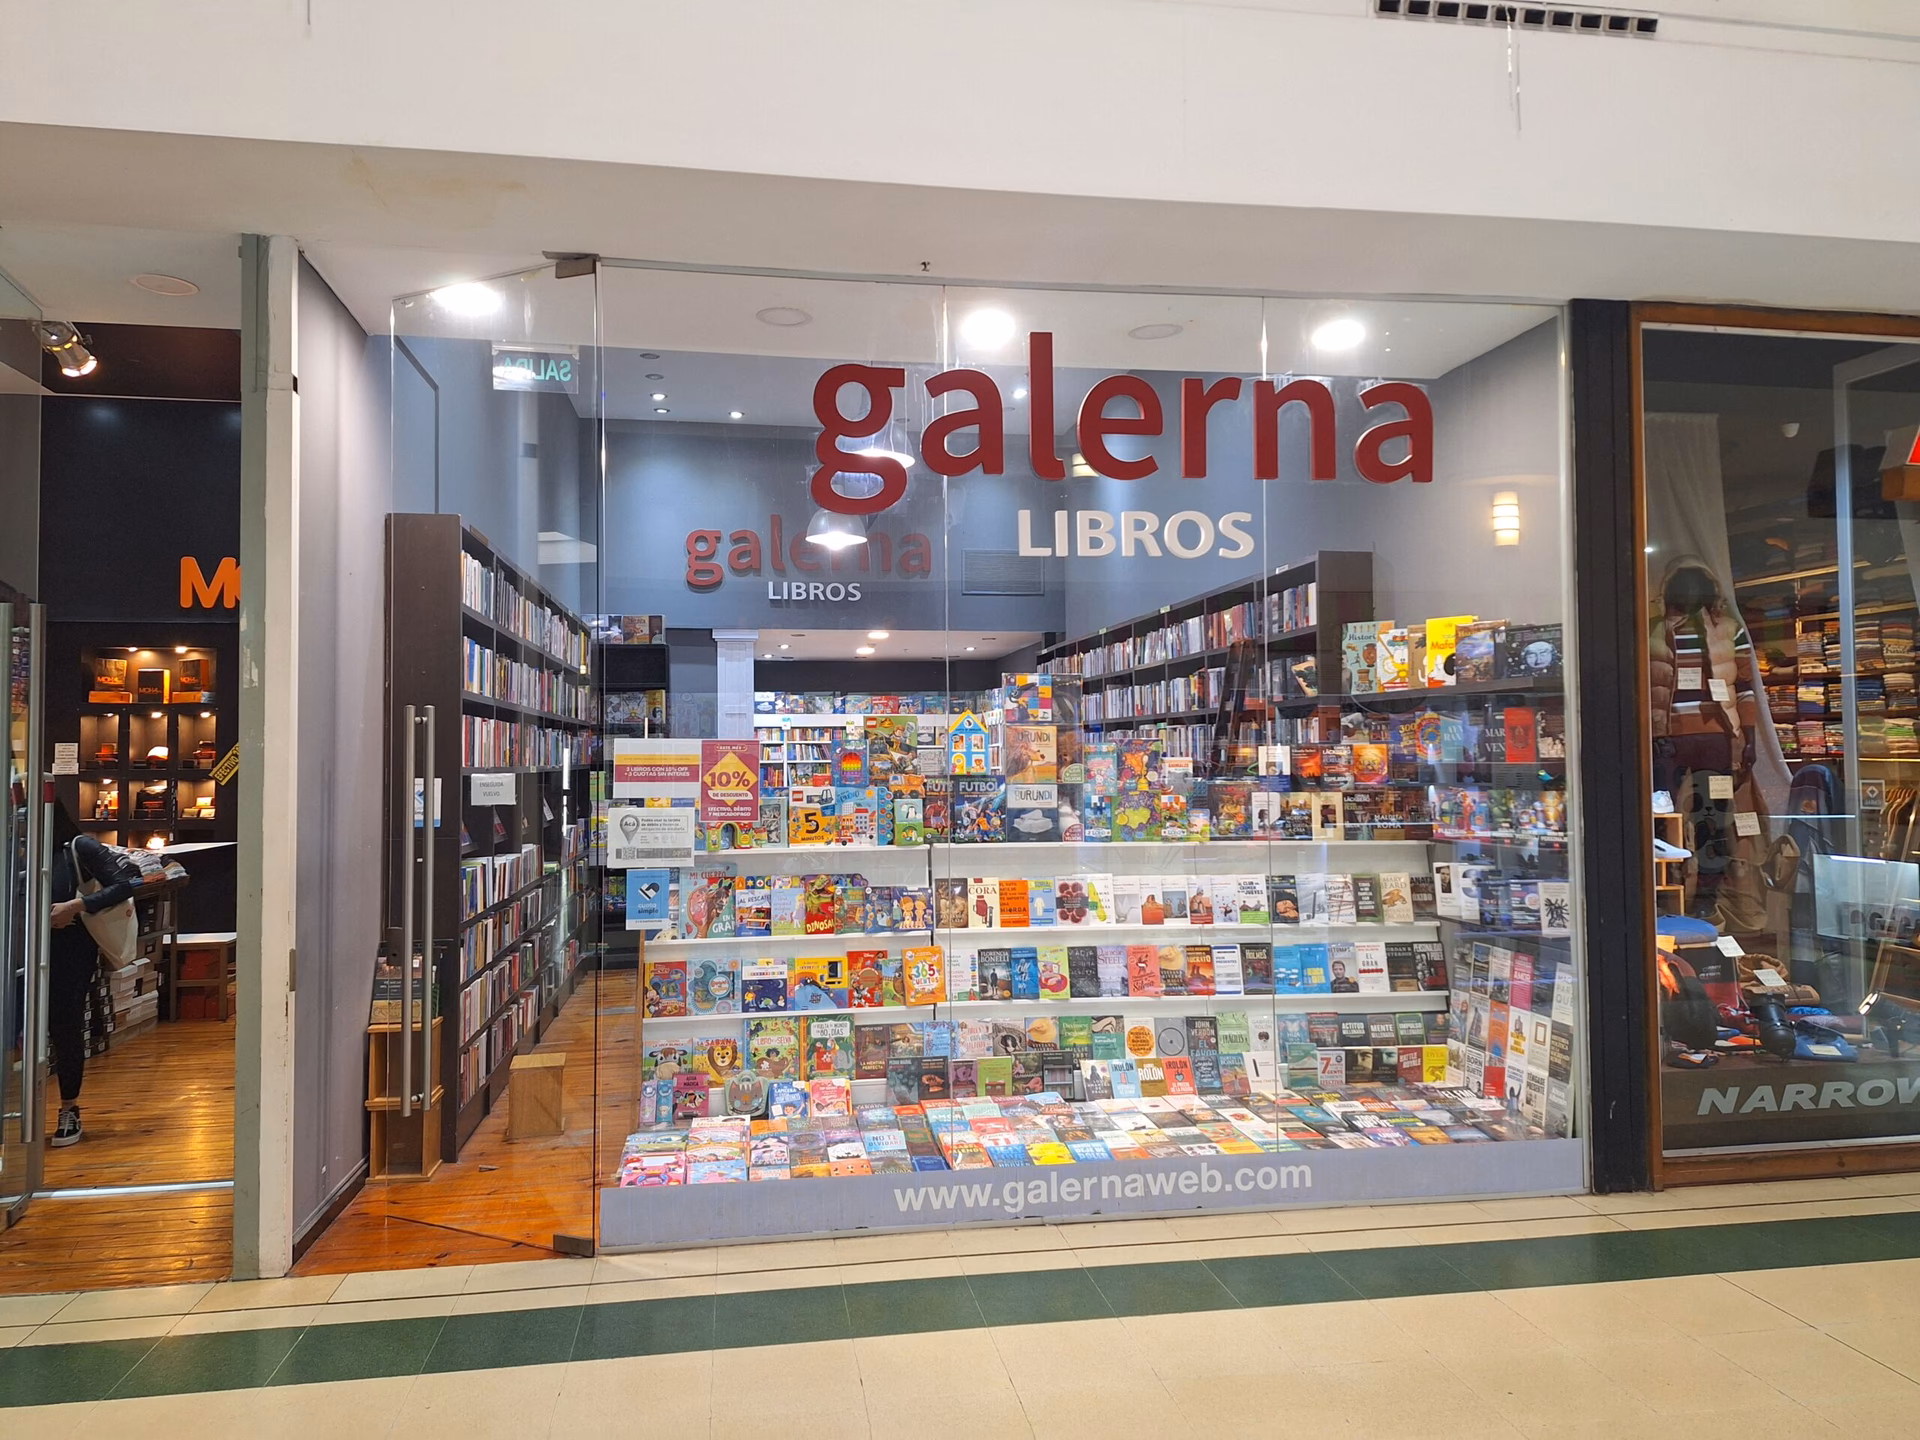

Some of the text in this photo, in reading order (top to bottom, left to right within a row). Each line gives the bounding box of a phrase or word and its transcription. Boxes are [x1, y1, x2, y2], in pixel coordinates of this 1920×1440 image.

[809, 331, 1434, 515] galerna
[1017, 510, 1255, 559] LIBROS
[685, 514, 932, 587] galerna
[766, 582, 862, 603] LIBROS
[214, 755, 239, 781] EFECTIVO
[708, 771, 751, 787] 10%
[959, 782, 1000, 791] FUTBOL
[1014, 789, 1053, 801] BURUNDI
[805, 812, 820, 834] 5
[968, 887, 997, 895] CORA
[637, 907, 658, 915] simple
[1098, 956, 1122, 965] STEEL
[1246, 951, 1267, 959] HOLMES
[913, 963, 936, 979] 365
[1342, 1022, 1365, 1030] ACTITUD
[1370, 1024, 1393, 1032] MENTE
[1198, 1040, 1208, 1048] EL
[1399, 1053, 1417, 1062] BATTLE
[1319, 1057, 1332, 1074] 7
[894, 1164, 1312, 1213] www.galernaweb.com
